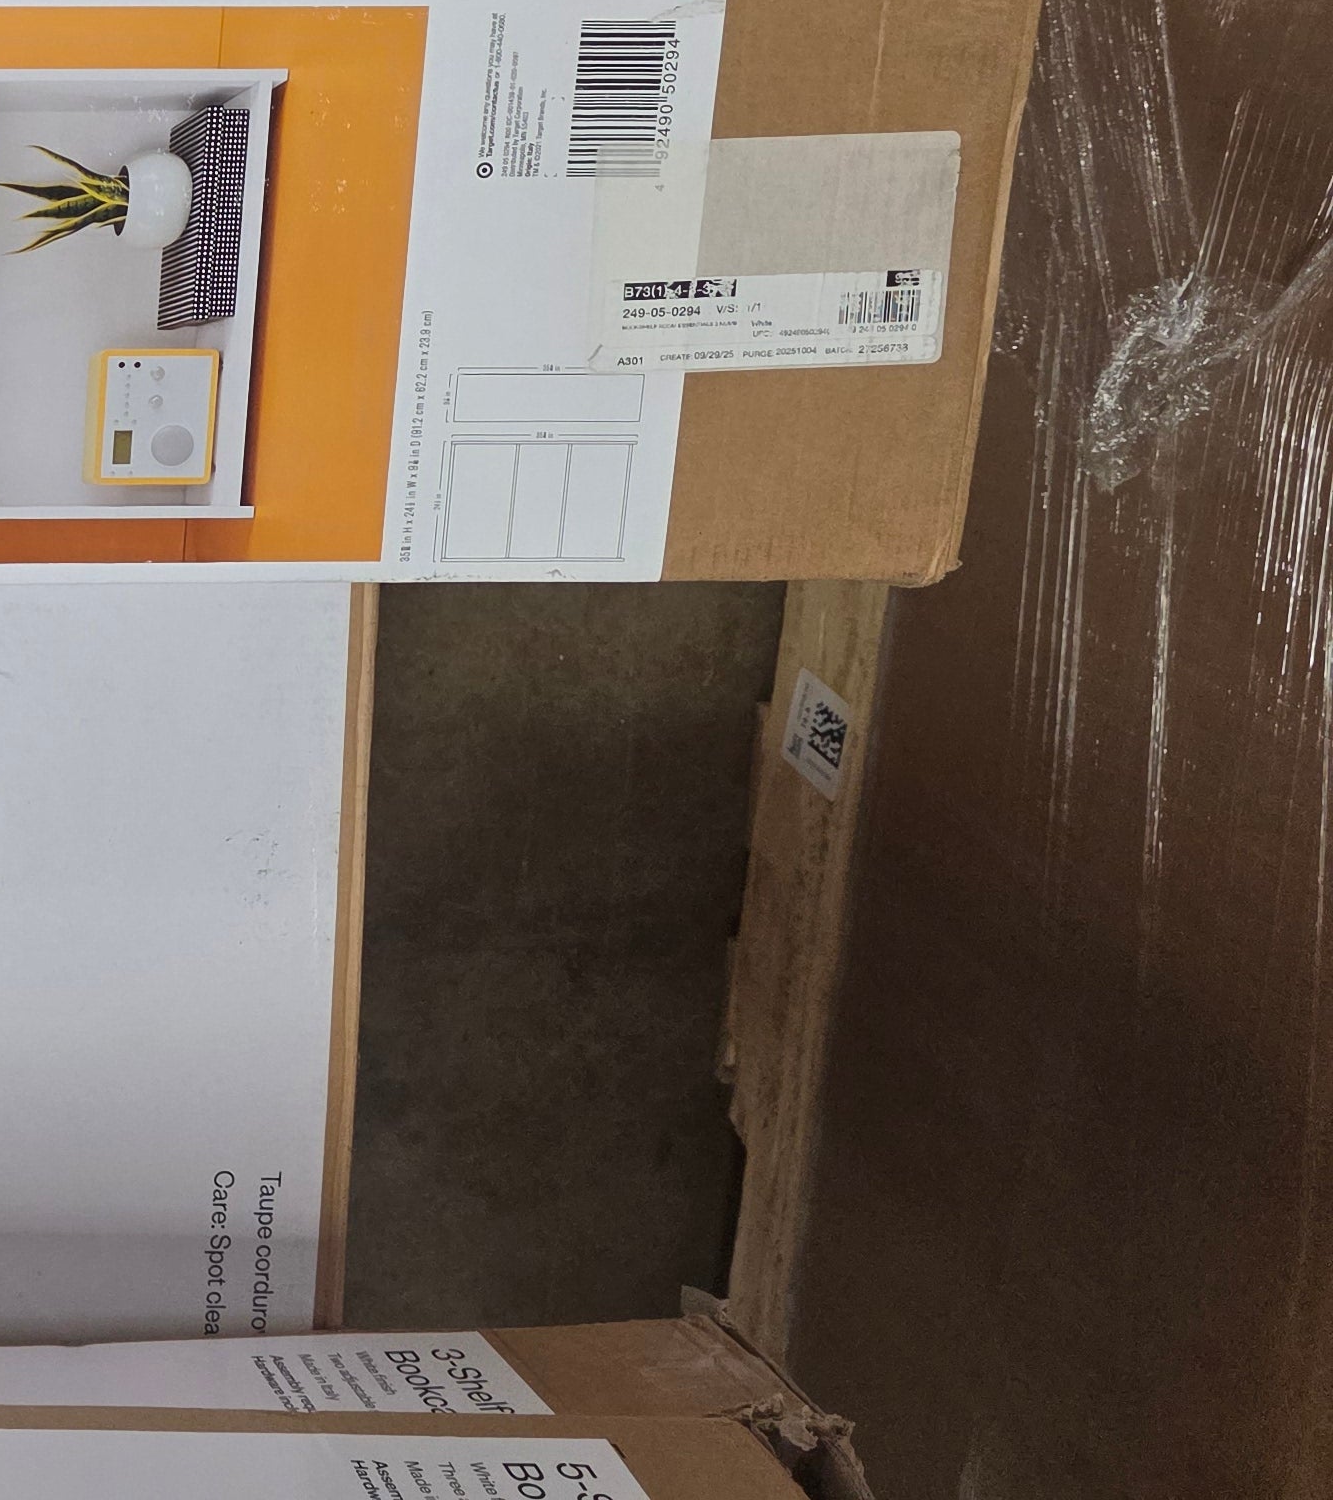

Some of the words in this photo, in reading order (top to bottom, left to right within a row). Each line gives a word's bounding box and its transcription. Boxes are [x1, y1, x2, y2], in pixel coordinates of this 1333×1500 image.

[662, 38, 681, 95] 50294
[622, 305, 701, 319] 249-05-0294
[617, 356, 644, 366] A301
[211, 1170, 235, 1228] Care:
[254, 1171, 282, 1238] Taupe
[204, 1235, 232, 1287] Spot
[251, 1245, 274, 1334] corduro
[403, 1459, 431, 1494] Made
[437, 1461, 466, 1498] Three
[469, 1461, 498, 1496] White
